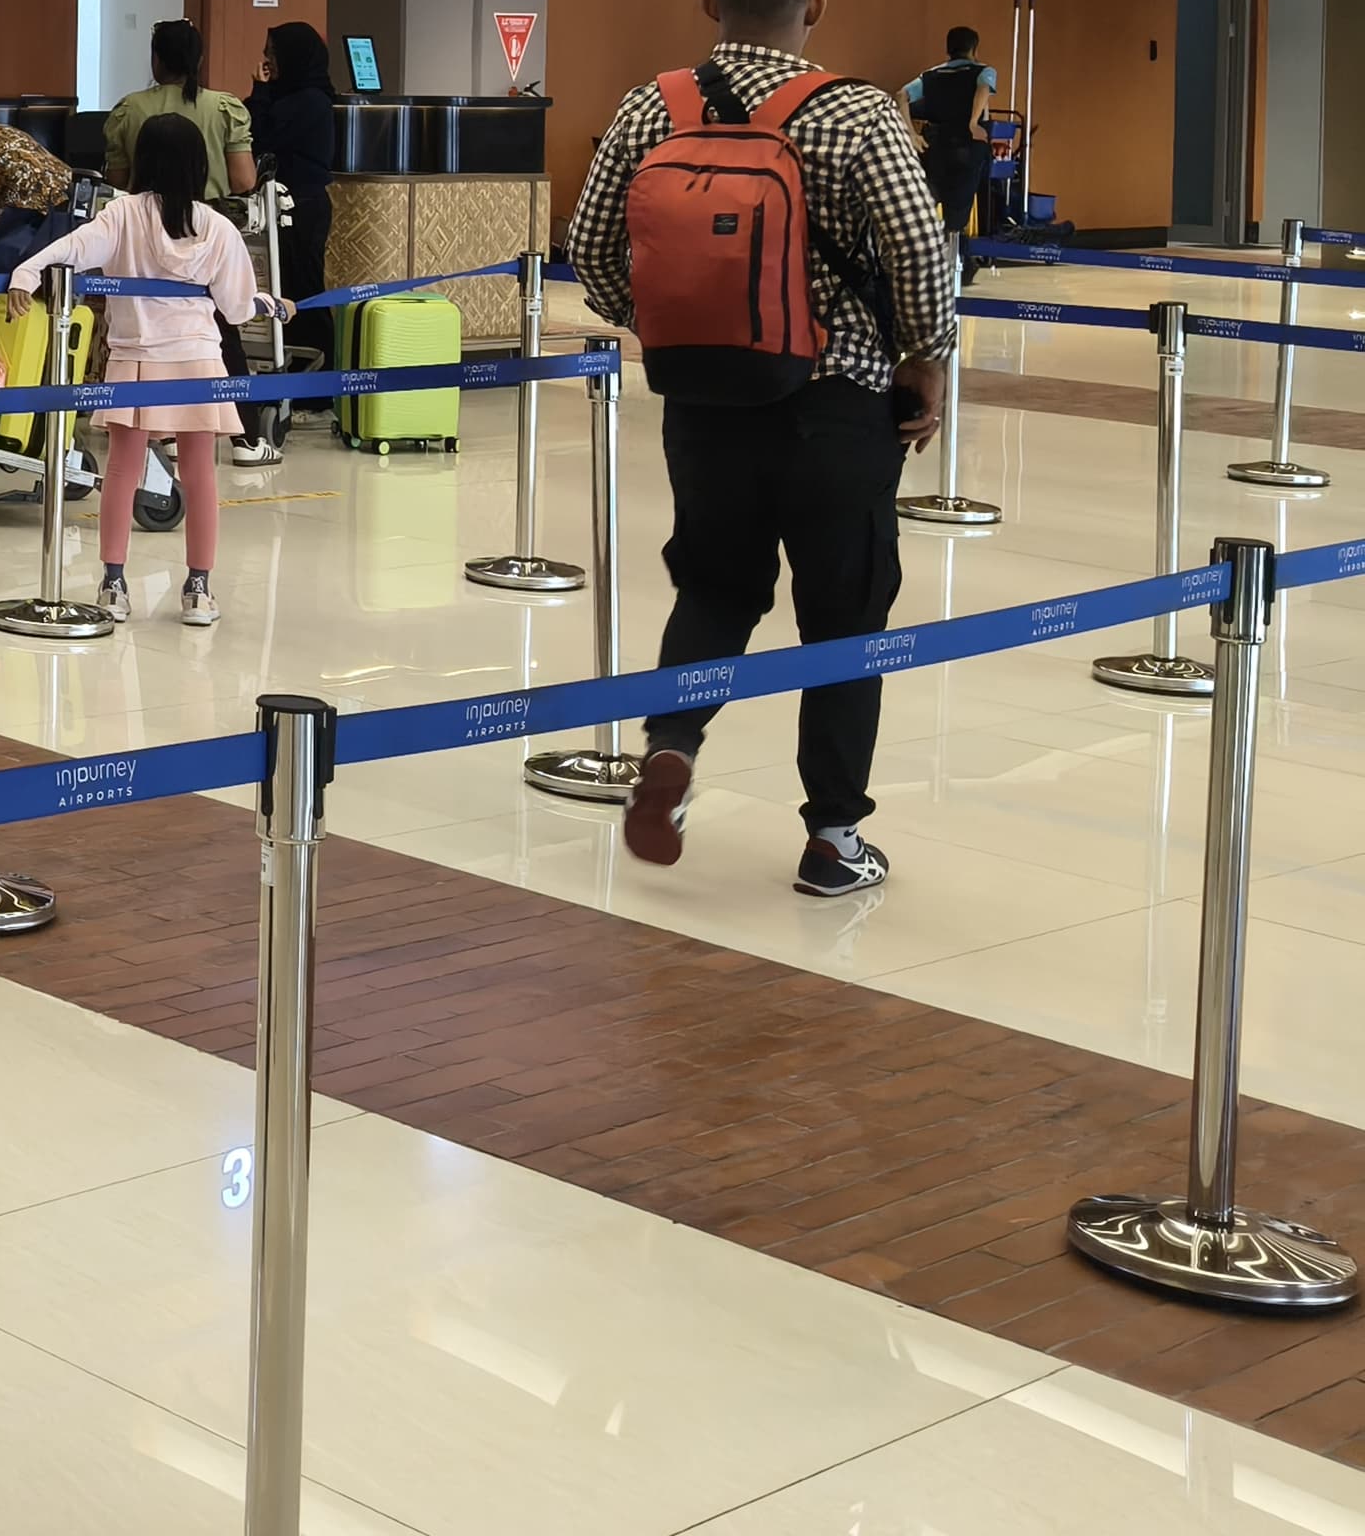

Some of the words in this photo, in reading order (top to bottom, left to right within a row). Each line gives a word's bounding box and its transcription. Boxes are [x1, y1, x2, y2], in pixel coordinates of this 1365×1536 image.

[865, 633, 917, 658] injourney
[677, 665, 734, 690] injourney
[466, 697, 531, 725] injourney
[466, 720, 526, 738] AIRPORTS
[56, 759, 136, 790] injourney
[59, 786, 132, 807] AIRPORTS
